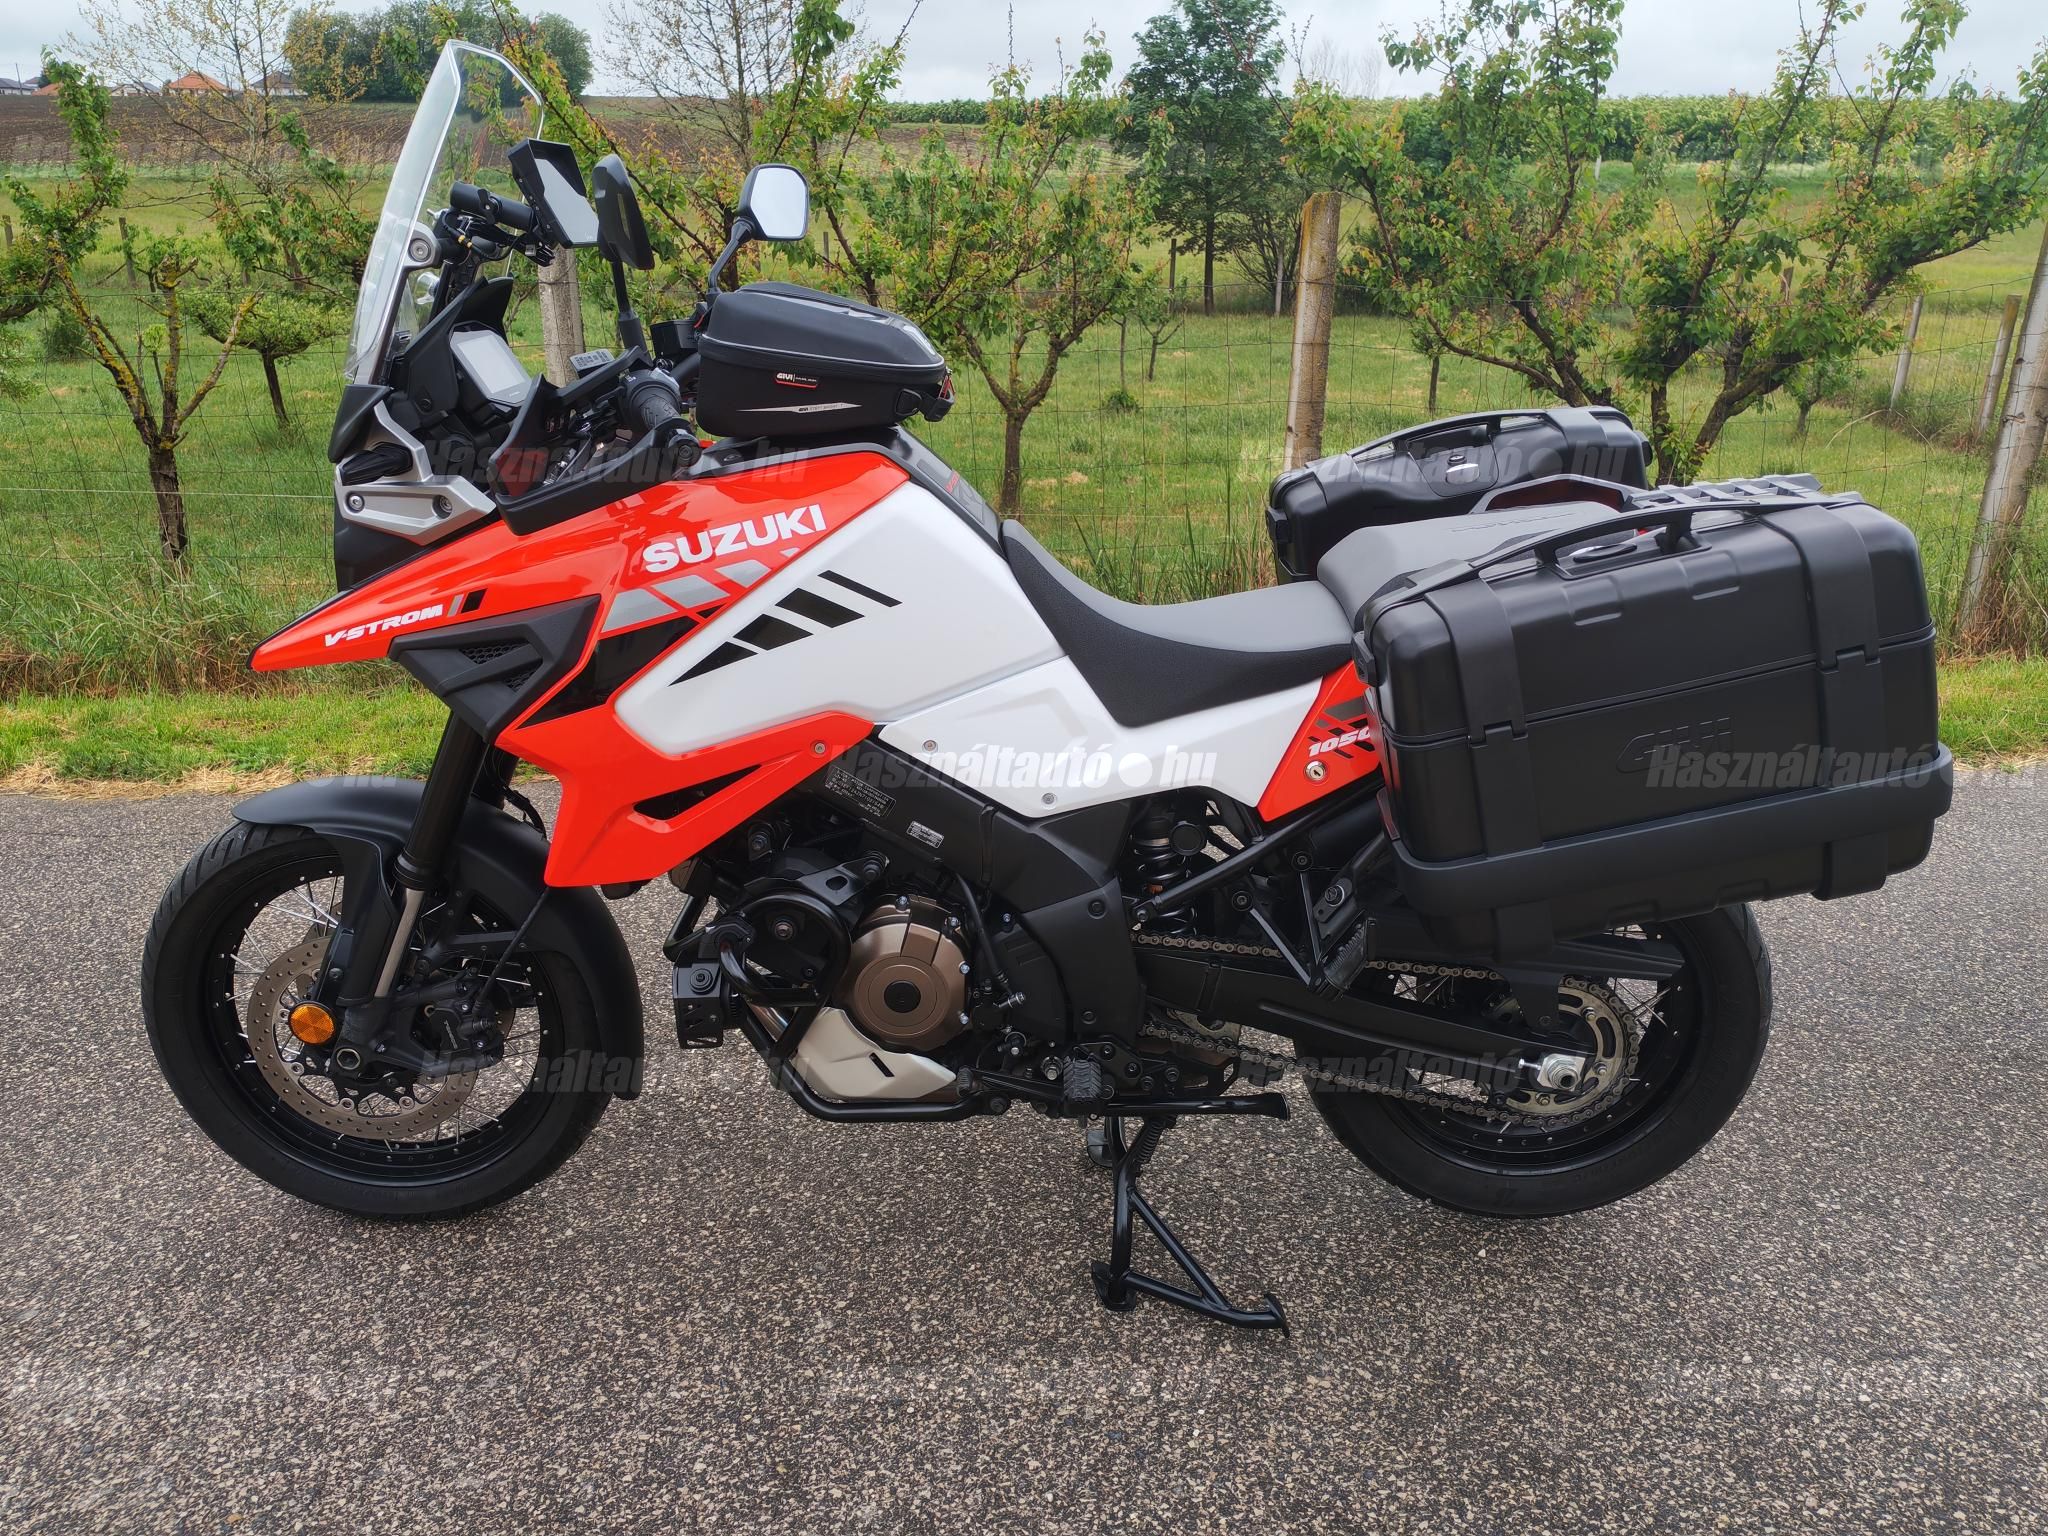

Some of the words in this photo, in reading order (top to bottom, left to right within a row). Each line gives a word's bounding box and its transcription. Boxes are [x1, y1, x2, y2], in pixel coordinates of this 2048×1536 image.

[776, 372, 794, 381] GIVI
[643, 504, 827, 573] SUZUKI
[325, 604, 443, 647] V-STROM
